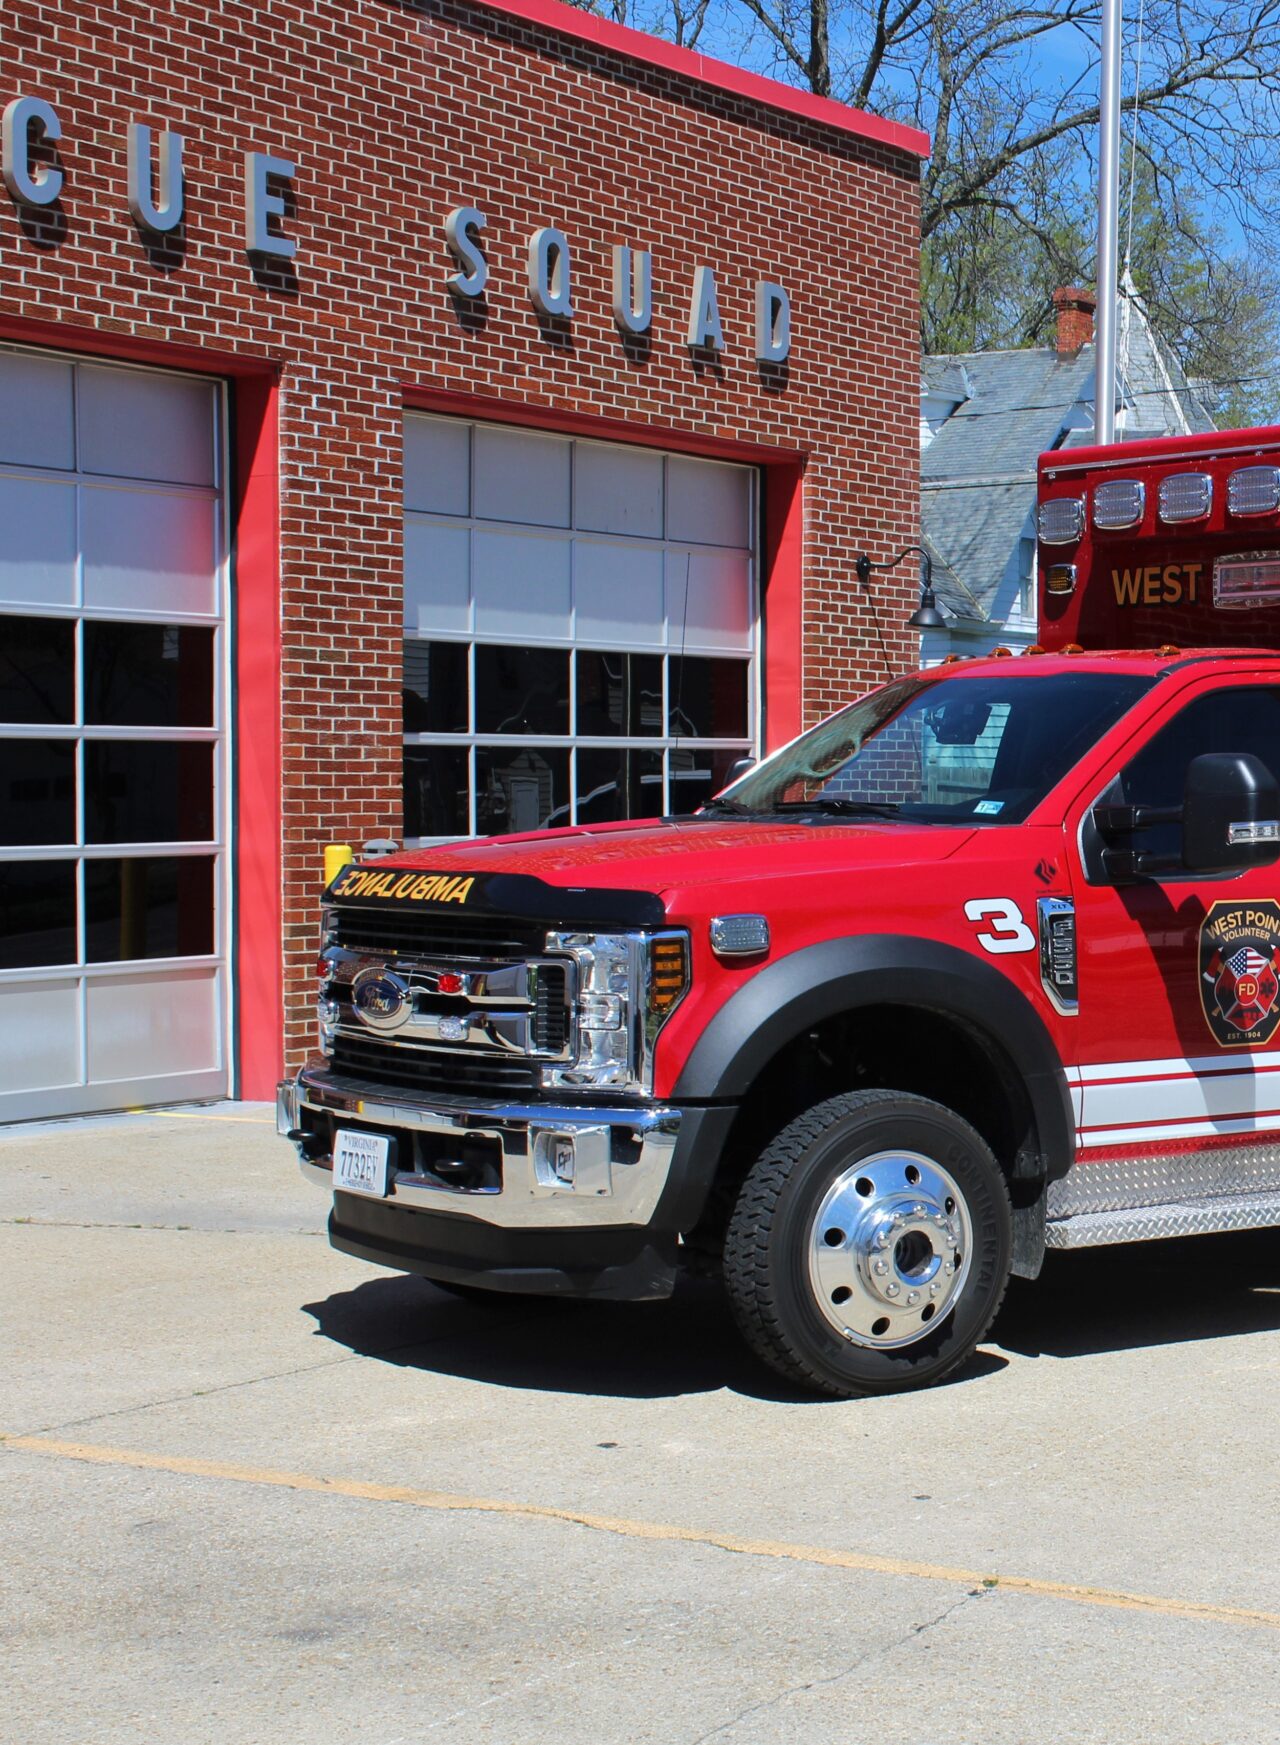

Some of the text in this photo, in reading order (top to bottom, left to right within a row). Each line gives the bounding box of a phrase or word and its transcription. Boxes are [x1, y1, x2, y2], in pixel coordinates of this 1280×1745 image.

[2, 95, 791, 362] CUE SQUAD
[1112, 563, 1203, 606] WEST
[963, 897, 1037, 955] 3
[1206, 910, 1243, 940] WEST
[1222, 927, 1271, 942] VOLUNTEER
[362, 985, 391, 1012] Ford
[1238, 983, 1256, 996] FD
[1227, 1031, 1261, 1040] EST. 1904
